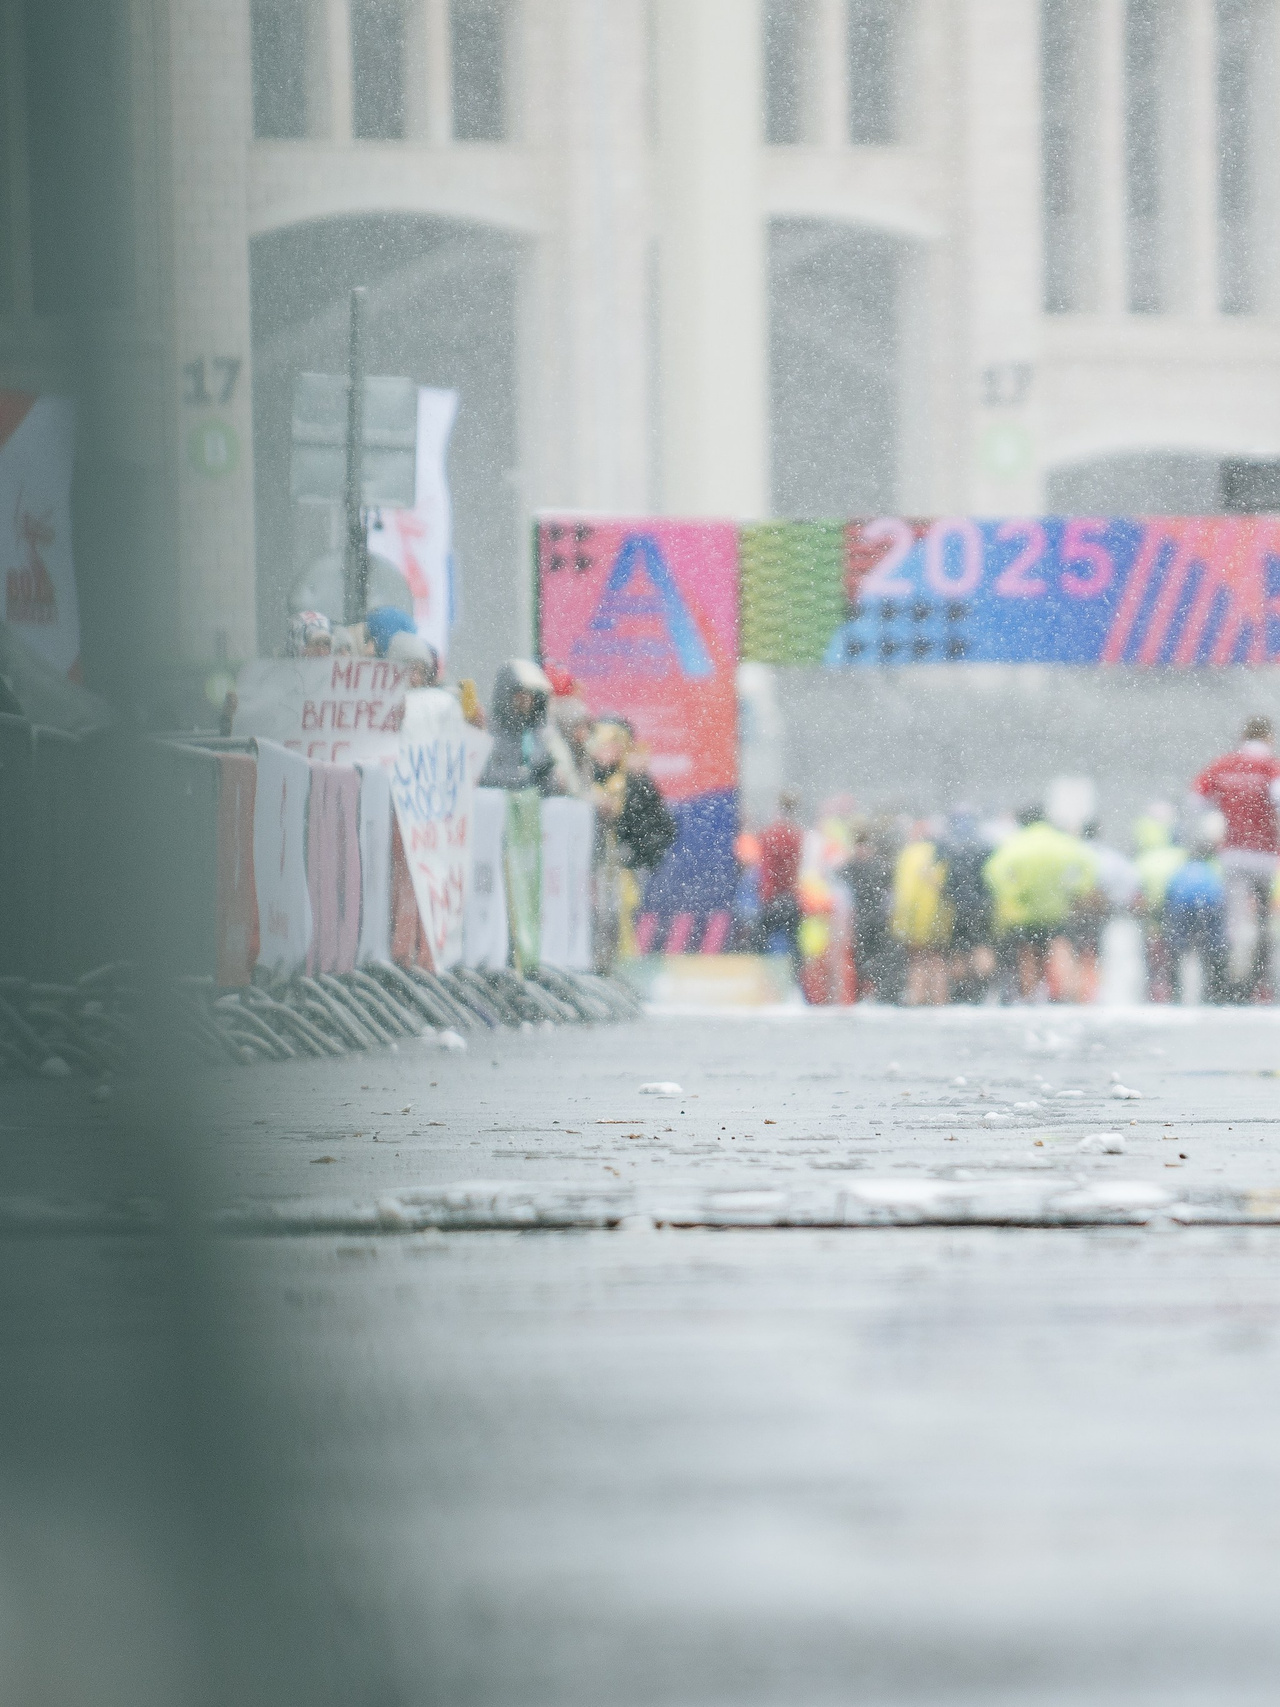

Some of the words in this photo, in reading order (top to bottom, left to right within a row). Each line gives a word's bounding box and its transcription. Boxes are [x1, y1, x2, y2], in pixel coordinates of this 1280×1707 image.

[183, 357, 243, 406] 17
[860, 517, 1114, 598] 2025
[331, 659, 408, 693] МГПУ
